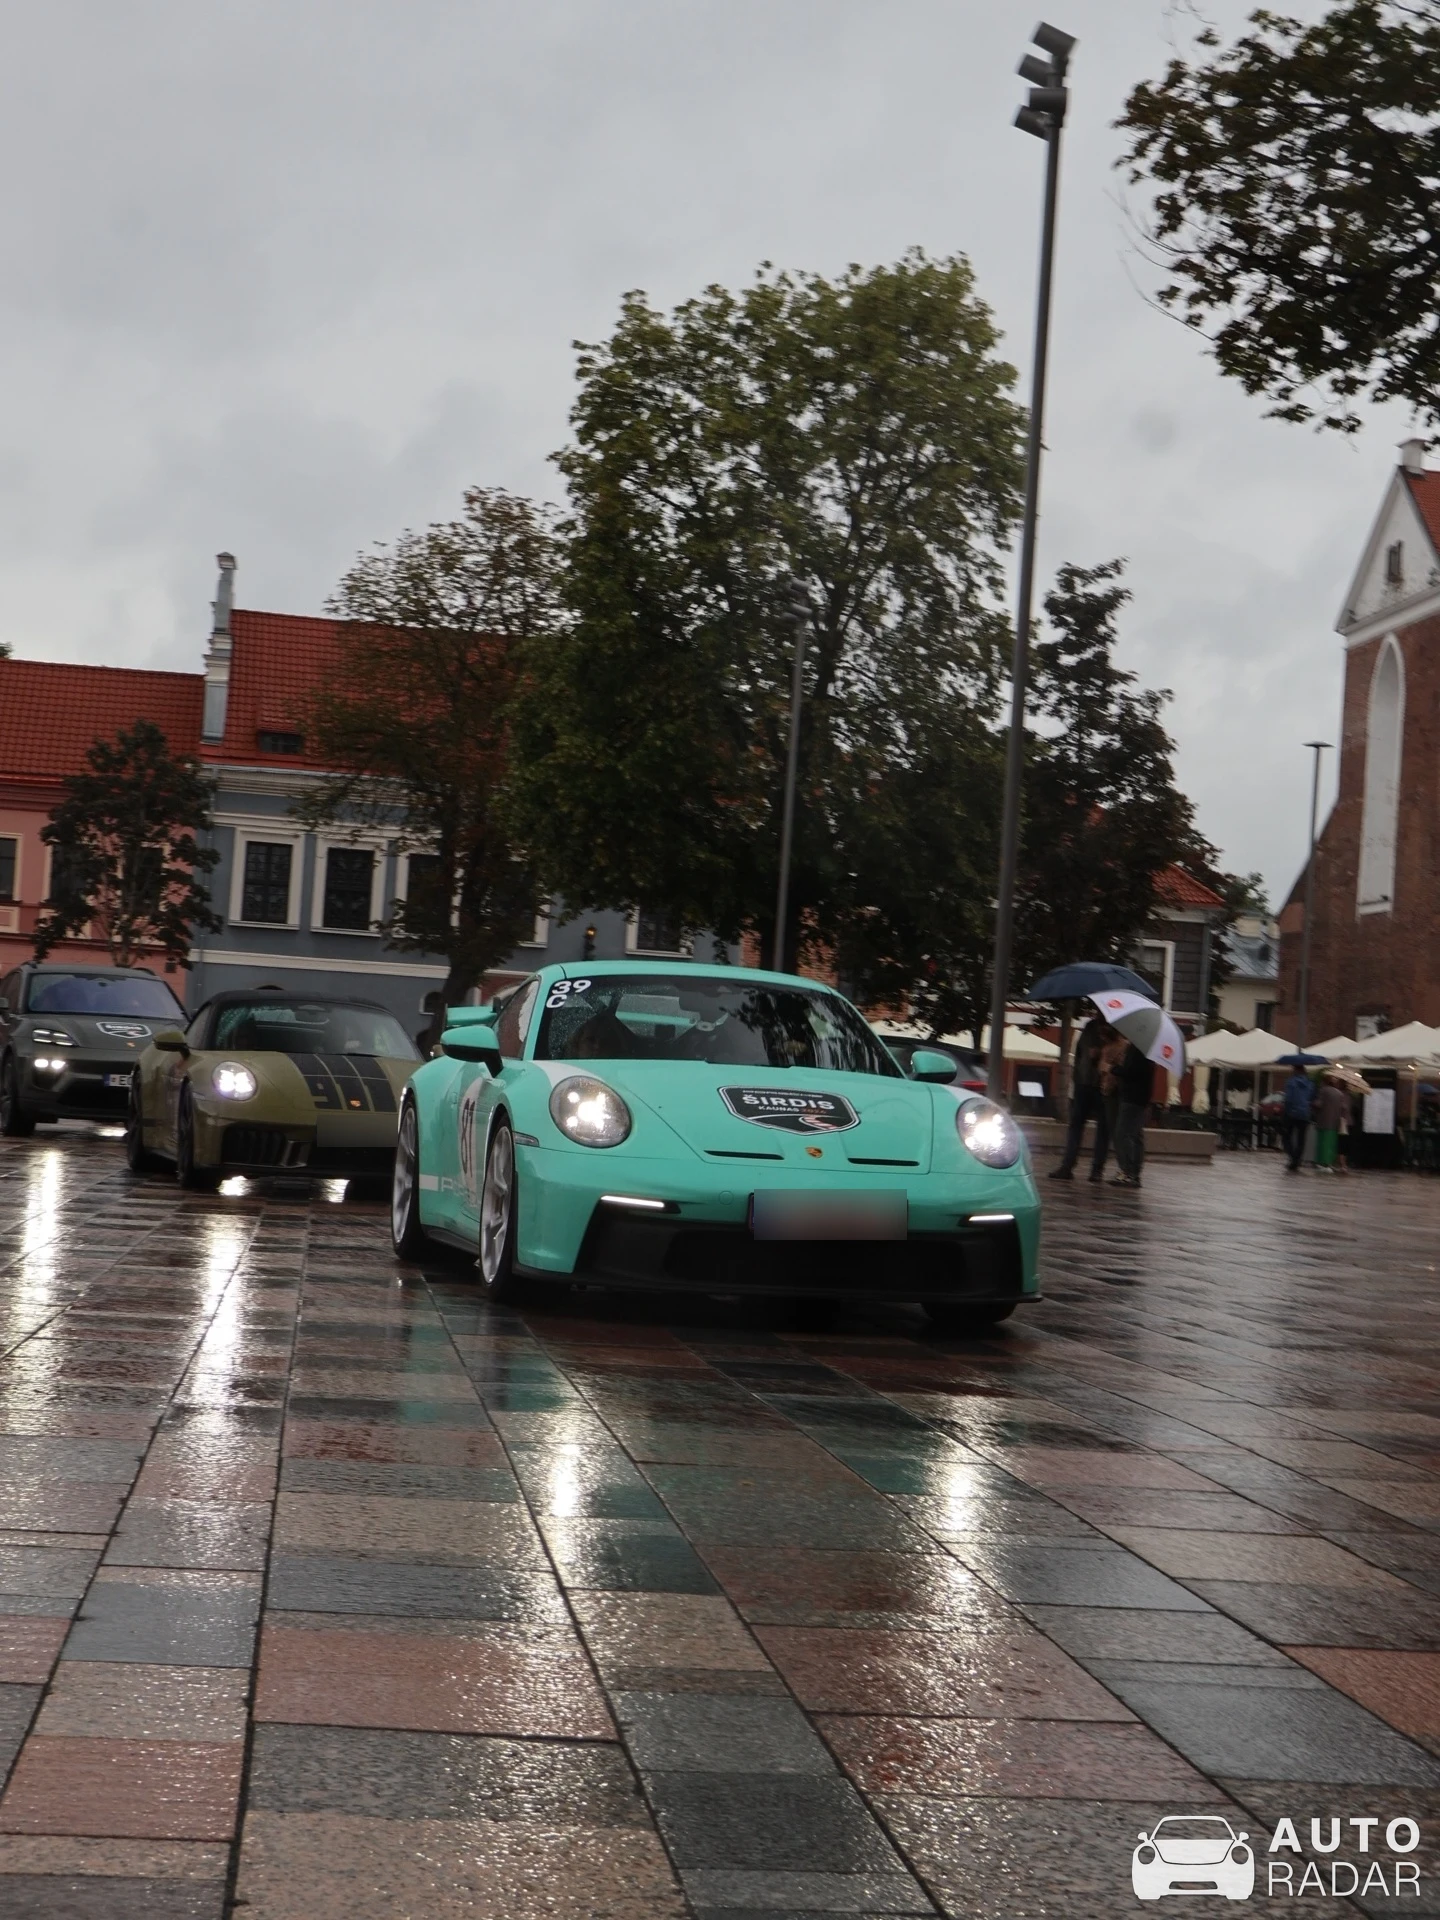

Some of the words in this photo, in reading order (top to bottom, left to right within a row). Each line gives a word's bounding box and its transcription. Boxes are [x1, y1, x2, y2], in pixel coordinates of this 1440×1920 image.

[551, 979, 592, 994] 39
[546, 994, 568, 1009] C
[742, 1094, 835, 1110] ŠIRDIS
[758, 1105, 800, 1113] KAUNAS
